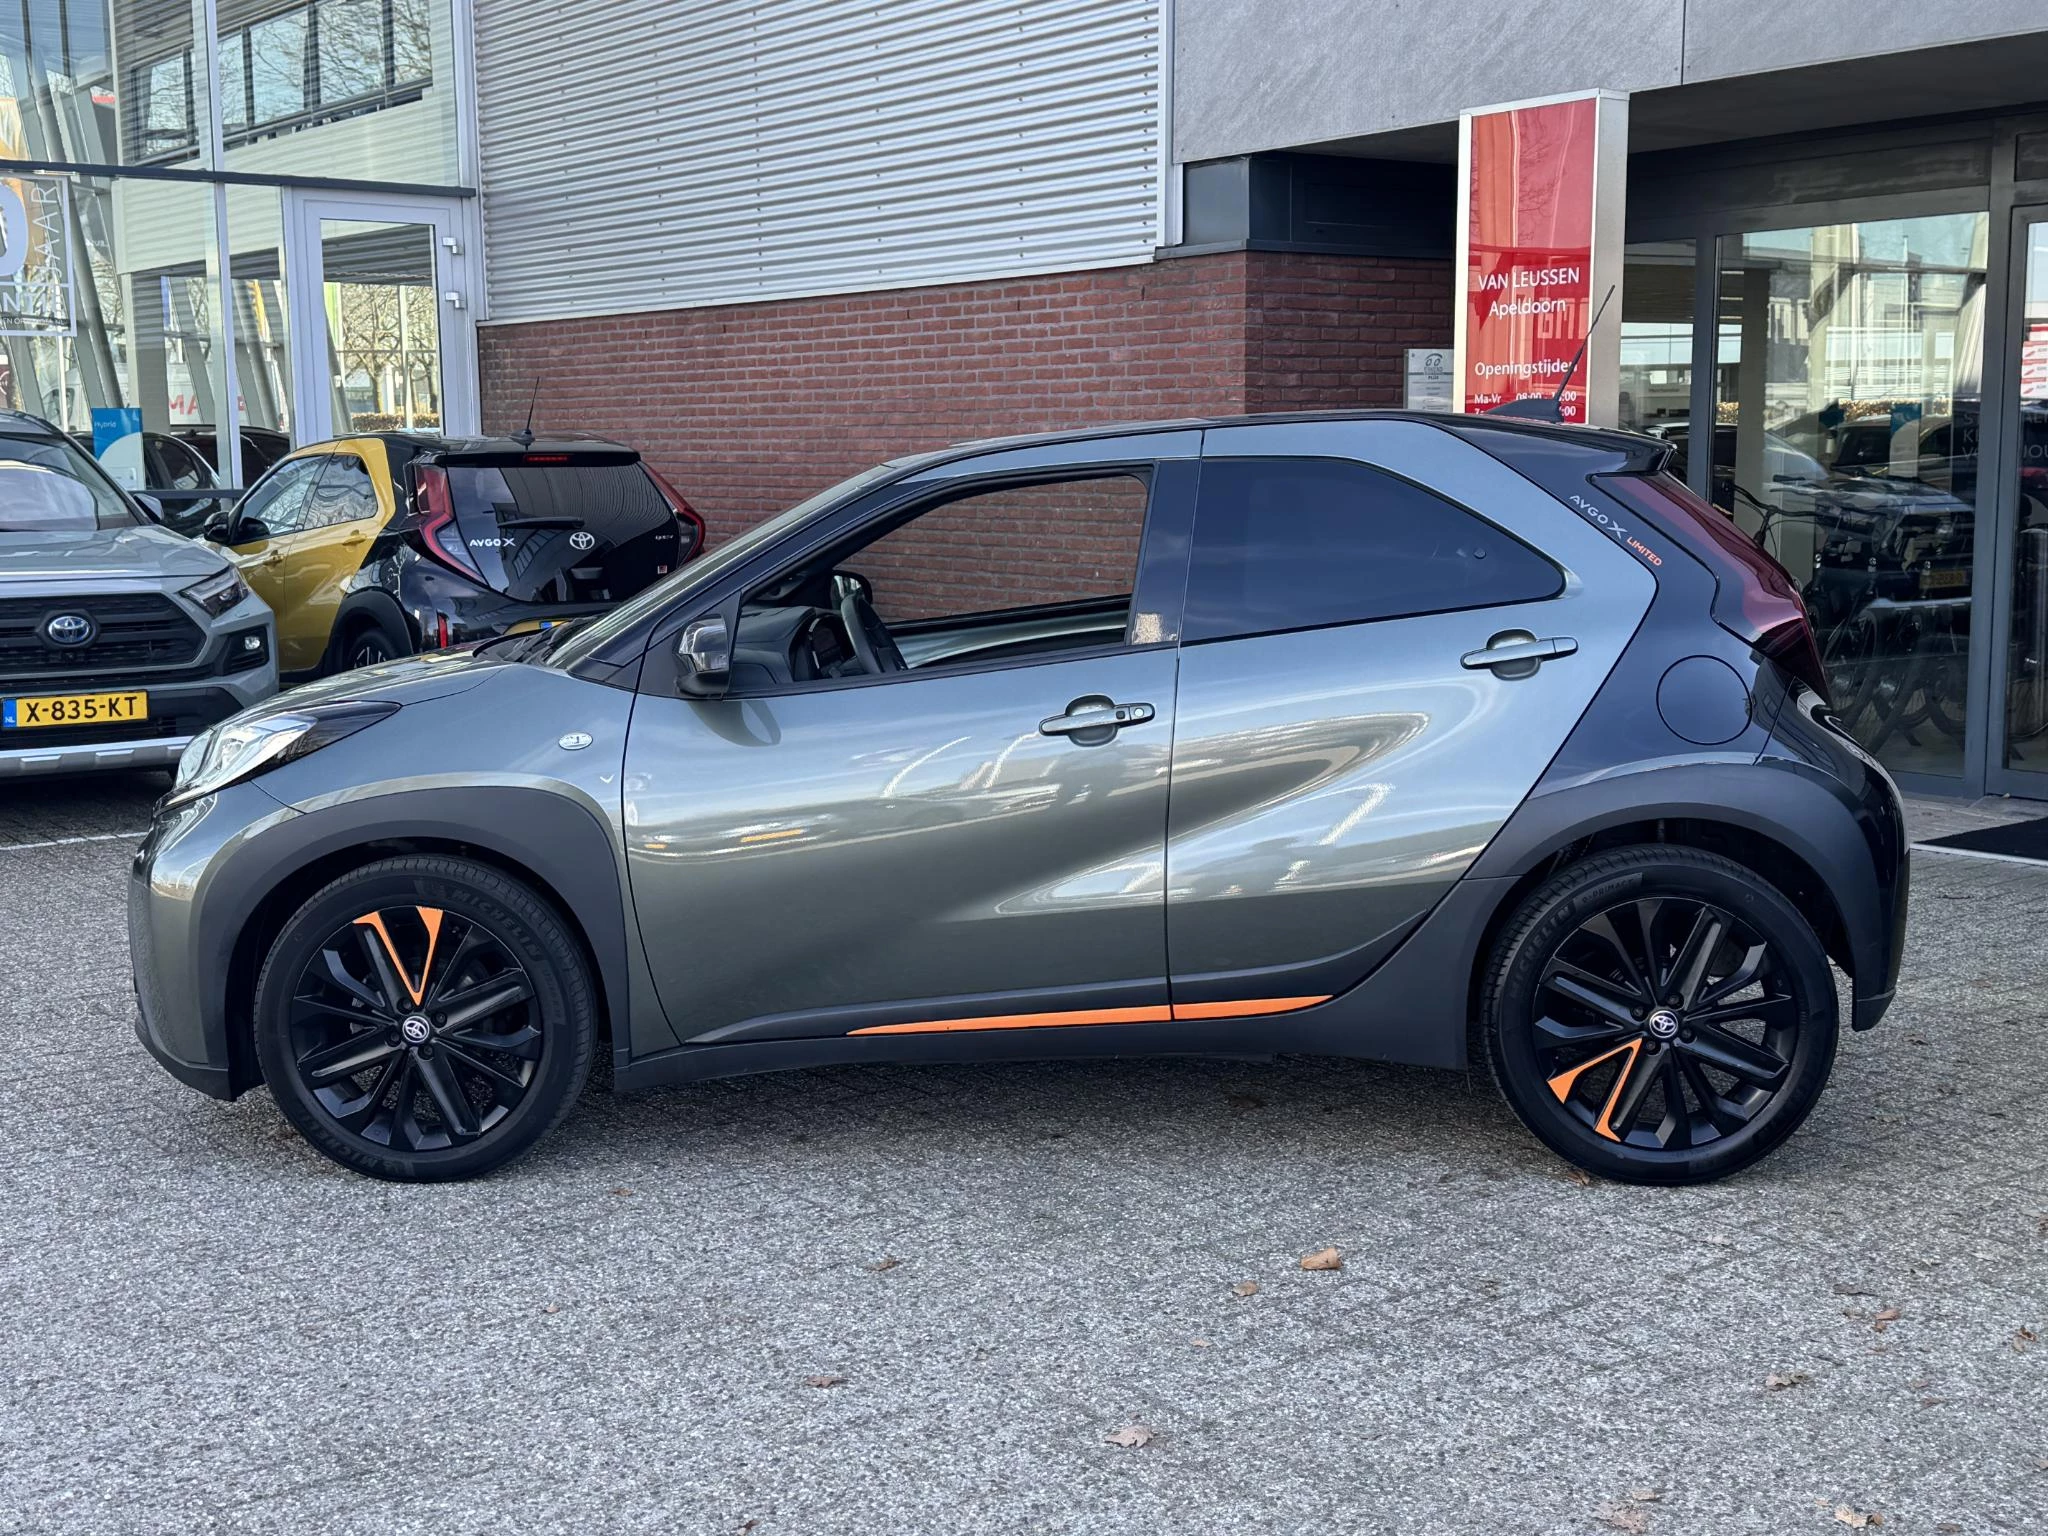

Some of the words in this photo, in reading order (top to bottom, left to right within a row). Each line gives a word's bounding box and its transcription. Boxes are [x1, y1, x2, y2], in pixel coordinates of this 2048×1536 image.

[1478, 273, 1509, 290] VAN
[1513, 267, 1580, 288] LEUSSEN
[1488, 298, 1566, 320] Apeldoorn
[1474, 392, 1502, 405] Ma-Vr
[502, 537, 517, 547] X
[1607, 520, 1628, 540] X
[1626, 536, 1662, 566] LIMITED
[26, 696, 138, 722] X-835-KT
